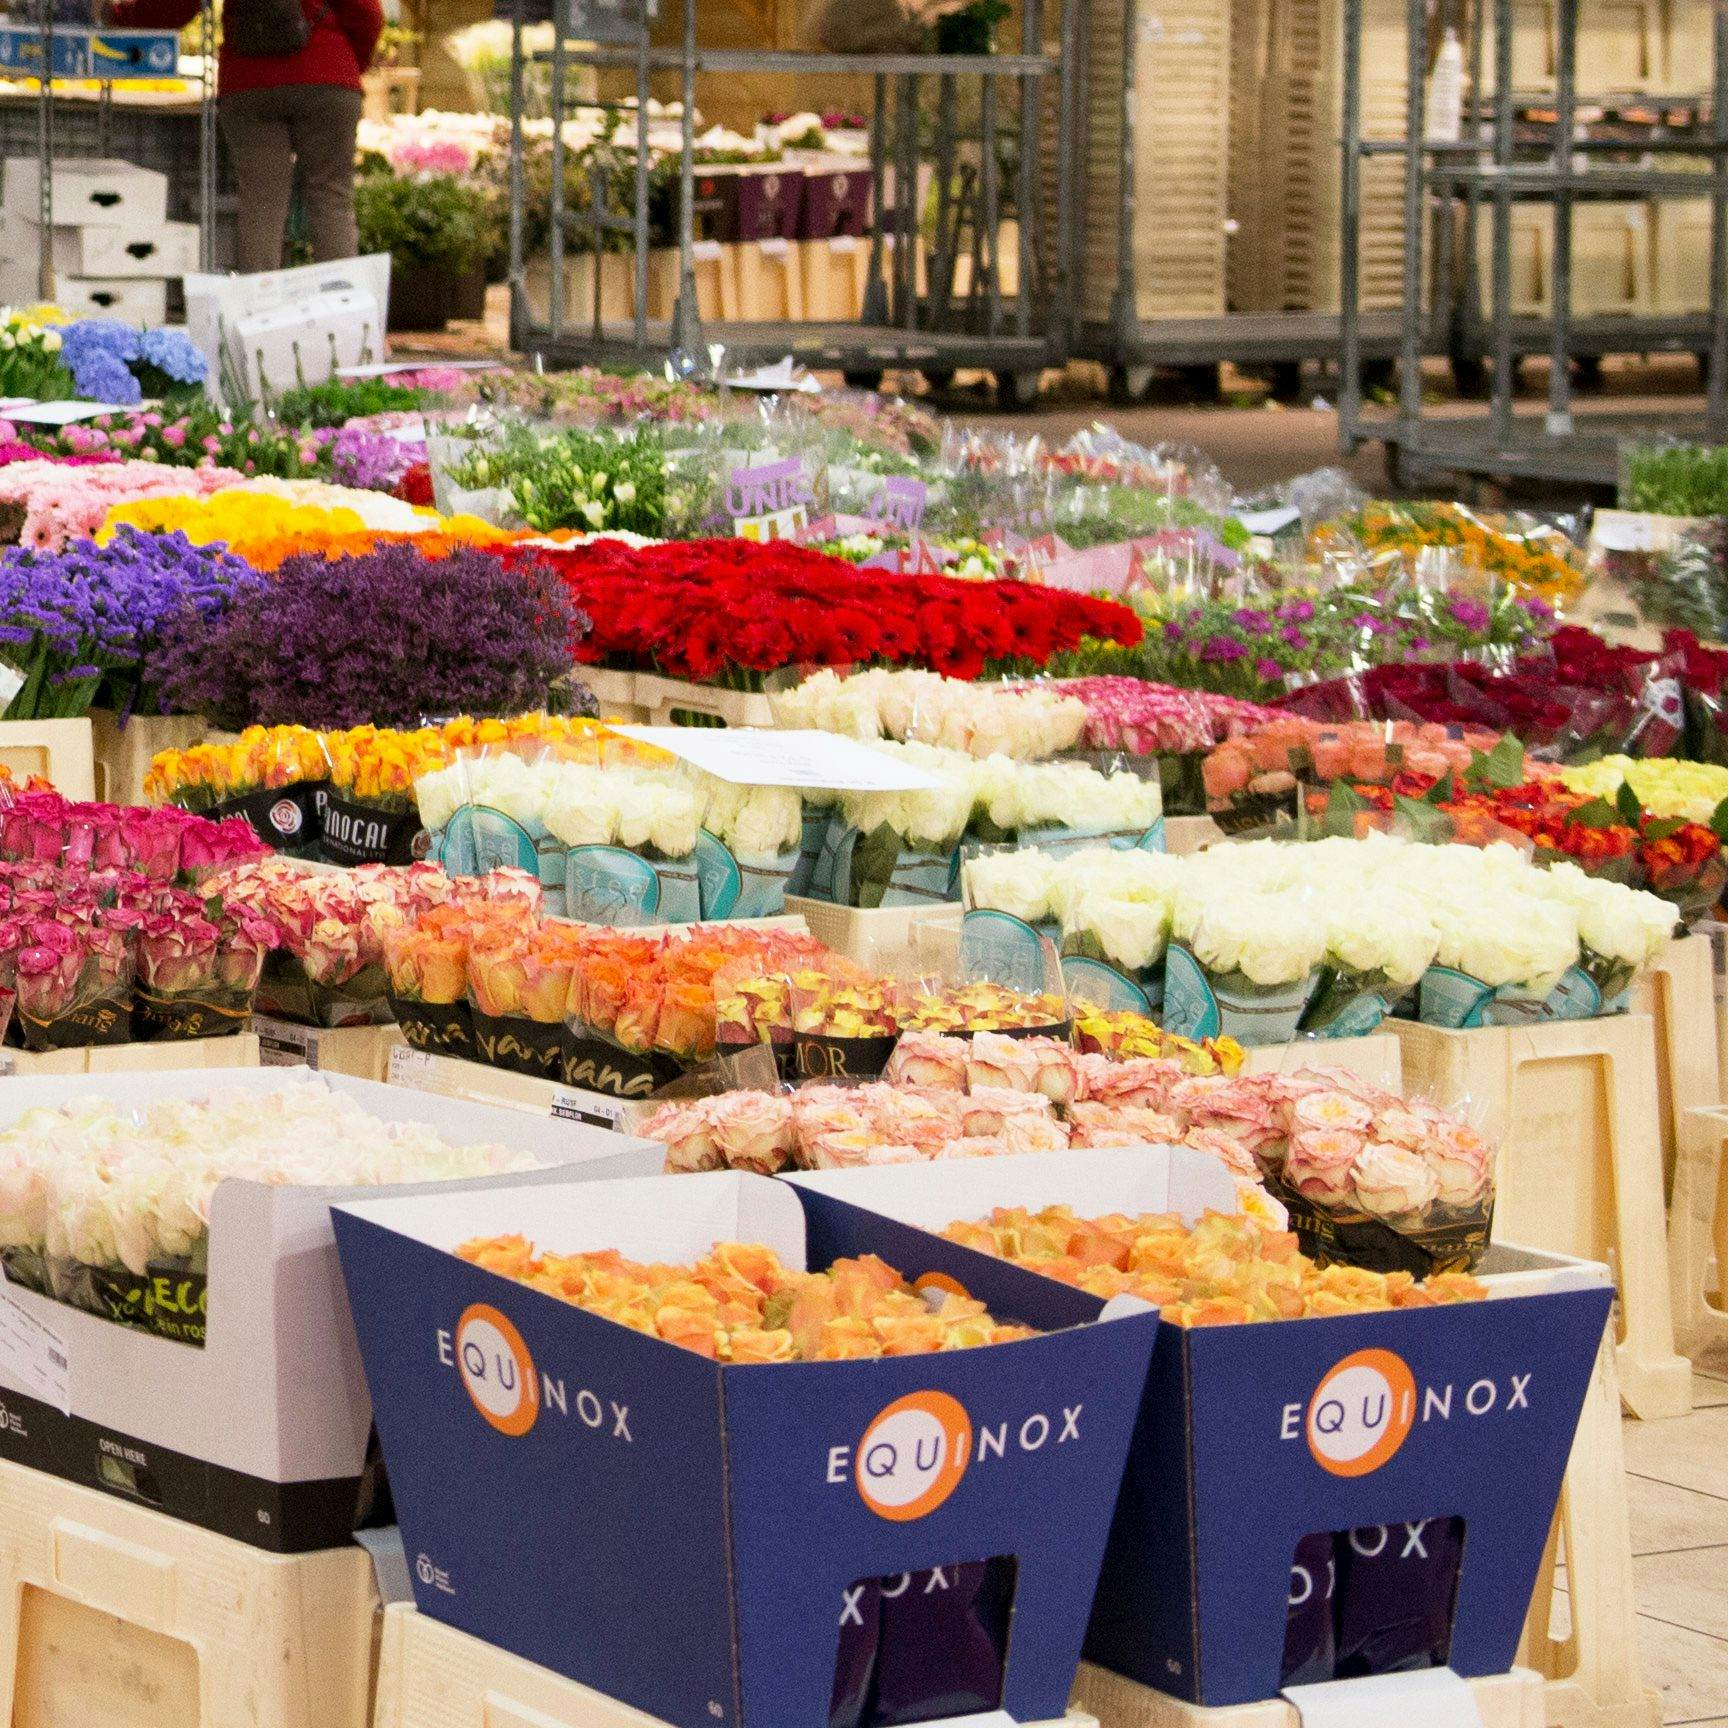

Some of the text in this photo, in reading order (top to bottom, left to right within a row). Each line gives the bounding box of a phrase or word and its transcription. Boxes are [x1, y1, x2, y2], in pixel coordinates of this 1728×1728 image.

[437, 1328, 633, 1443] EQUINOX
[1280, 1373, 1532, 1441] EQUINOX
[826, 1403, 1083, 1484] EQUINOX
